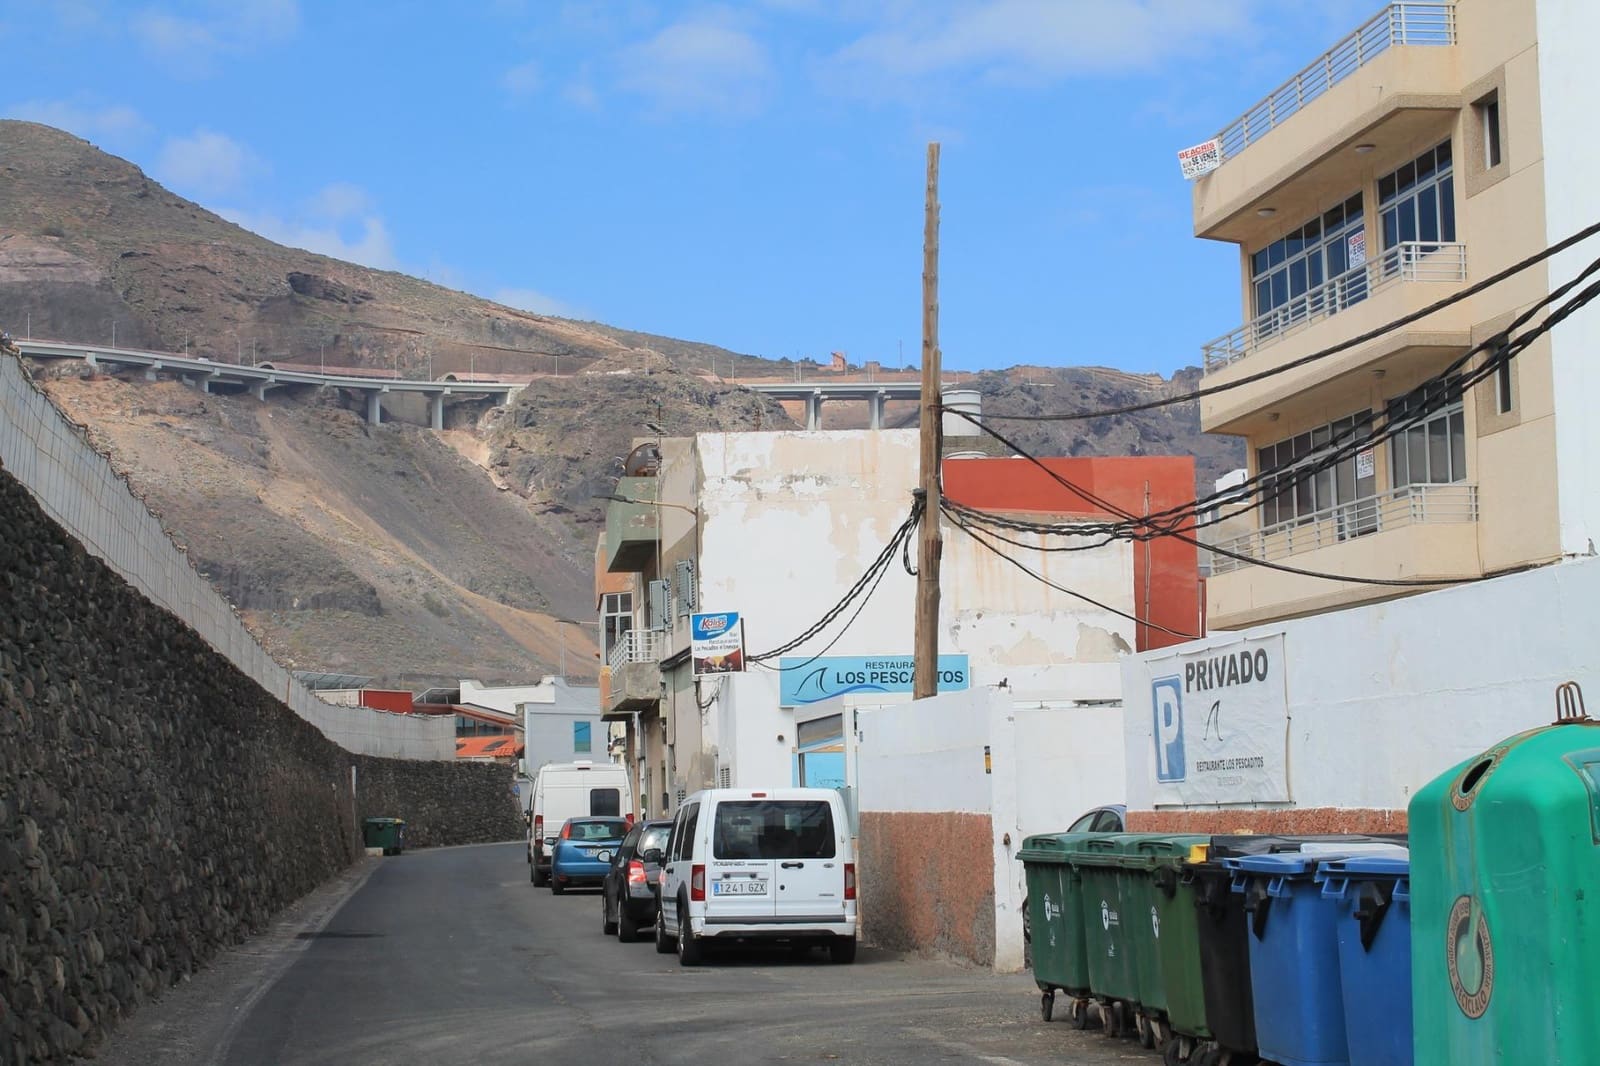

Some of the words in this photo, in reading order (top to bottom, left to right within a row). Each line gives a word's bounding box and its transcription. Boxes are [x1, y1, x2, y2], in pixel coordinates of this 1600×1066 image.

[1191, 156, 1200, 166] SE
[1200, 149, 1218, 162] VENDE
[865, 661, 915, 670] RESTAURA
[1185, 648, 1268, 693] PRIVADO
[836, 671, 866, 684] LOS
[870, 670, 964, 684] PESCATOS
[1156, 685, 1180, 775] P
[1196, 760, 1226, 772] RESTAURANTE
[1226, 759, 1235, 770] LOS
[720, 883, 744, 893] 1241
[748, 883, 765, 893] GZX
